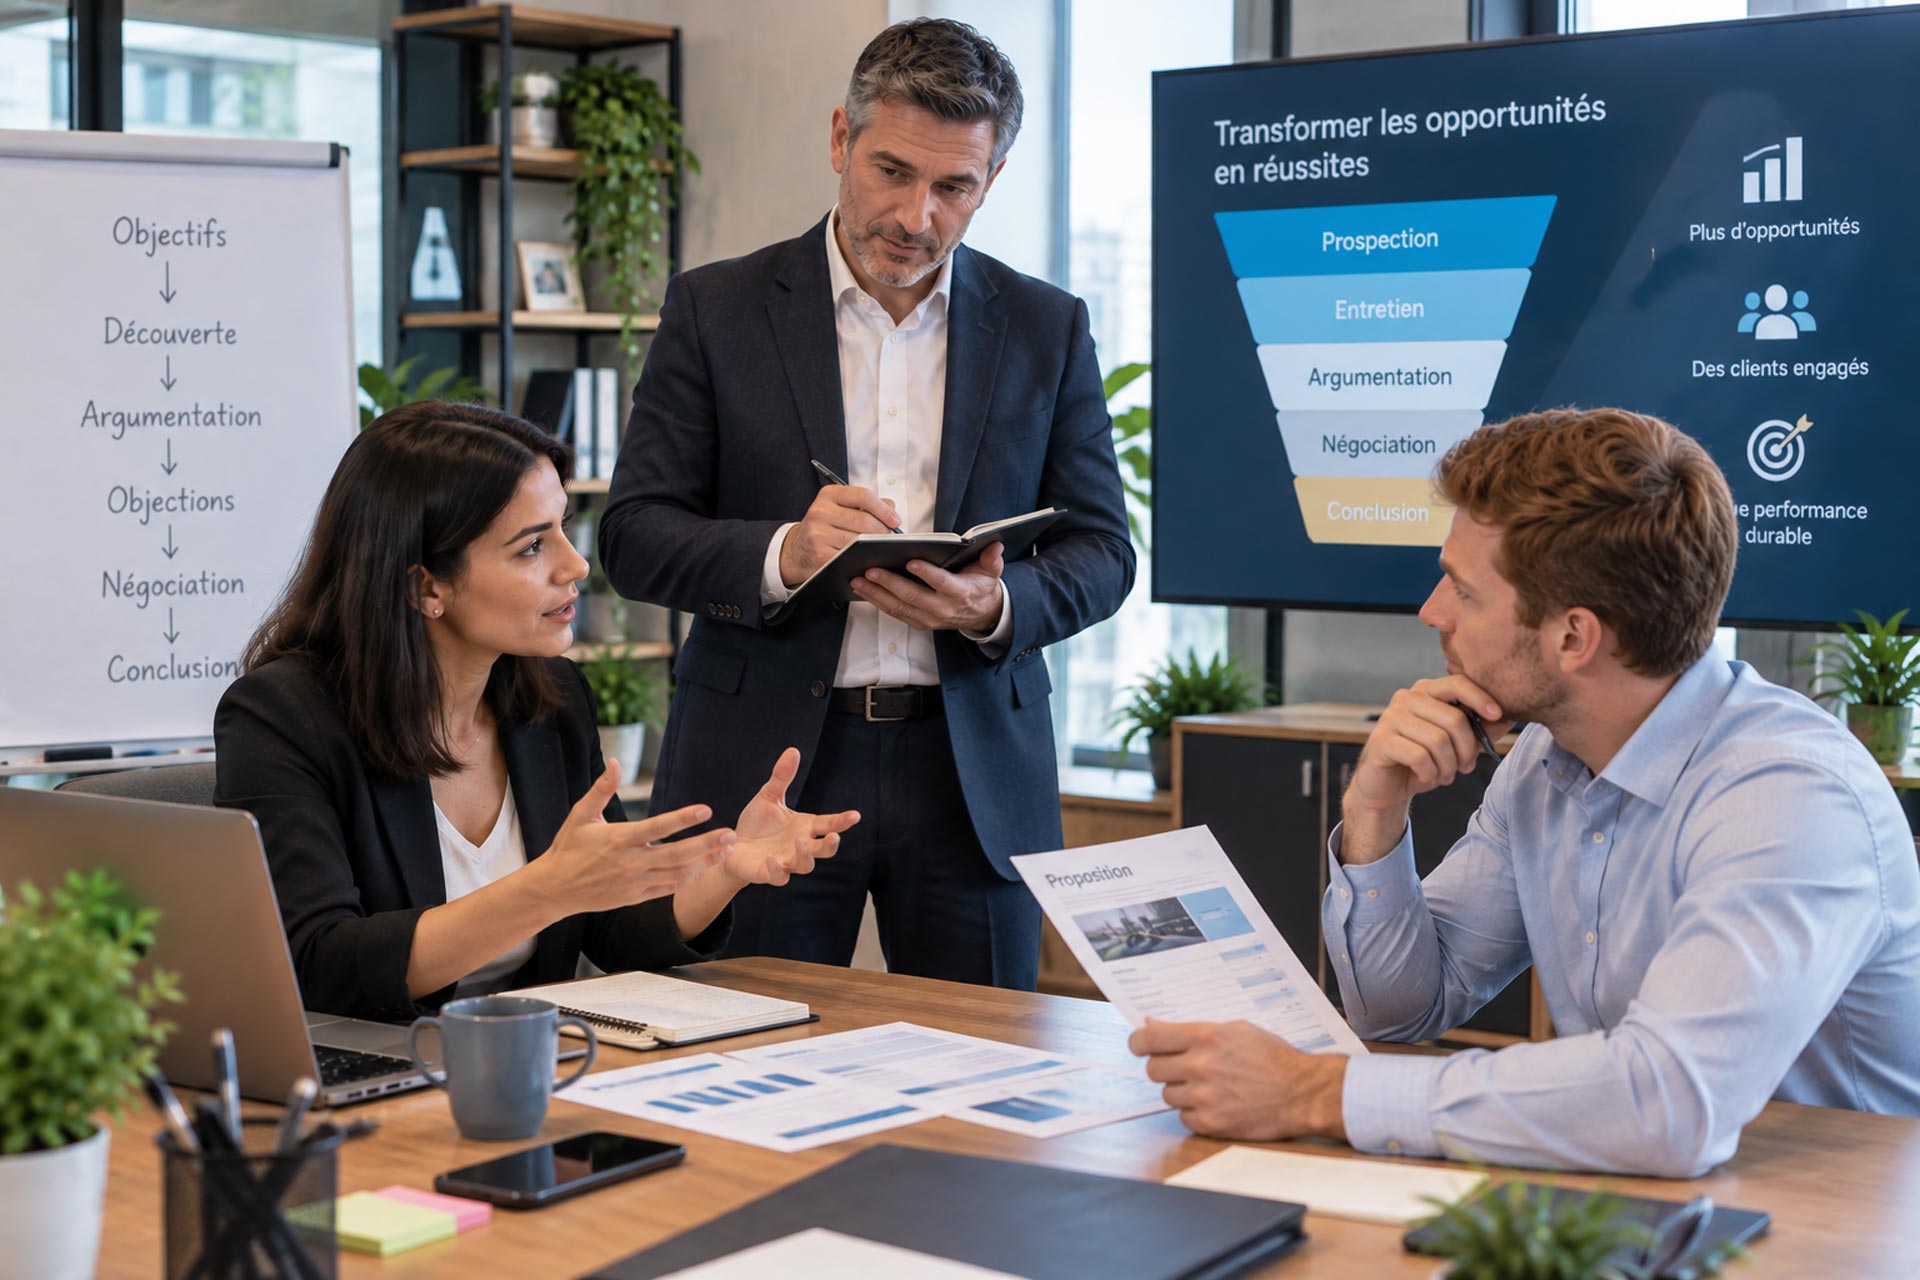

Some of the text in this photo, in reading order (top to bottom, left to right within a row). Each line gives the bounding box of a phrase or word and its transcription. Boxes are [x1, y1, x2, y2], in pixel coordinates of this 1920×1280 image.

[1213, 93, 1607, 147] Transformer les opportunités
[1214, 152, 1370, 185] en réussites
[112, 215, 227, 258] Objectifs
[1322, 227, 1439, 256] Prospection
[1689, 216, 1860, 243] Plus d'opportunités
[1335, 297, 1425, 320] Entretien
[104, 316, 237, 345] Découverte
[1308, 367, 1452, 391] Argumentation
[1692, 356, 1869, 381] Des clients engagés
[80, 400, 262, 441] Argumentation
[1322, 434, 1436, 459] Négociation
[107, 485, 235, 525] Objections
[1327, 500, 1429, 522] Conclusion
[1754, 499, 1868, 522] performance
[1745, 525, 1813, 545] durable
[102, 570, 244, 608] Négociation
[107, 652, 238, 683] Conclusion
[1045, 865, 1133, 888] Proposition
